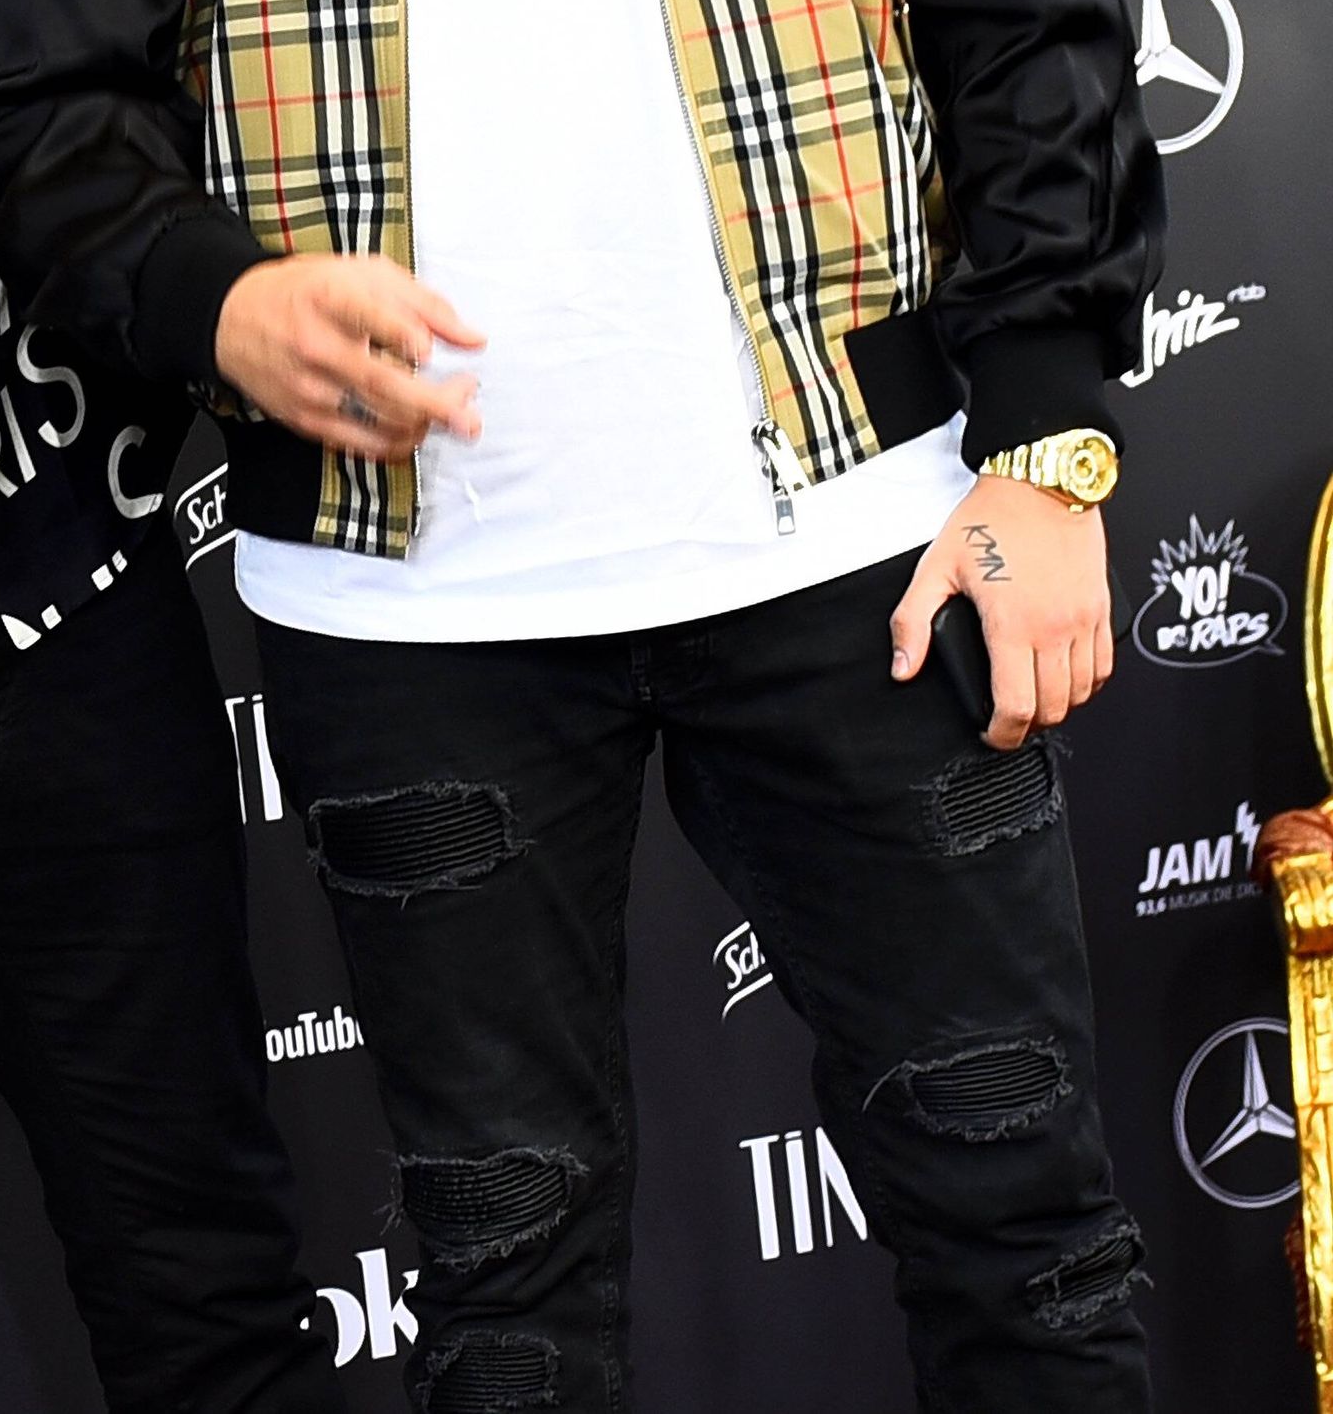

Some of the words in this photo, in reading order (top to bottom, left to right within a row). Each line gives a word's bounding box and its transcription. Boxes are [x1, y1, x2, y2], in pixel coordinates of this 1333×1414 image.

[1171, 559, 1231, 619] YO!
[1189, 613, 1270, 652] RAPS
[1138, 835, 1233, 894] JAM
